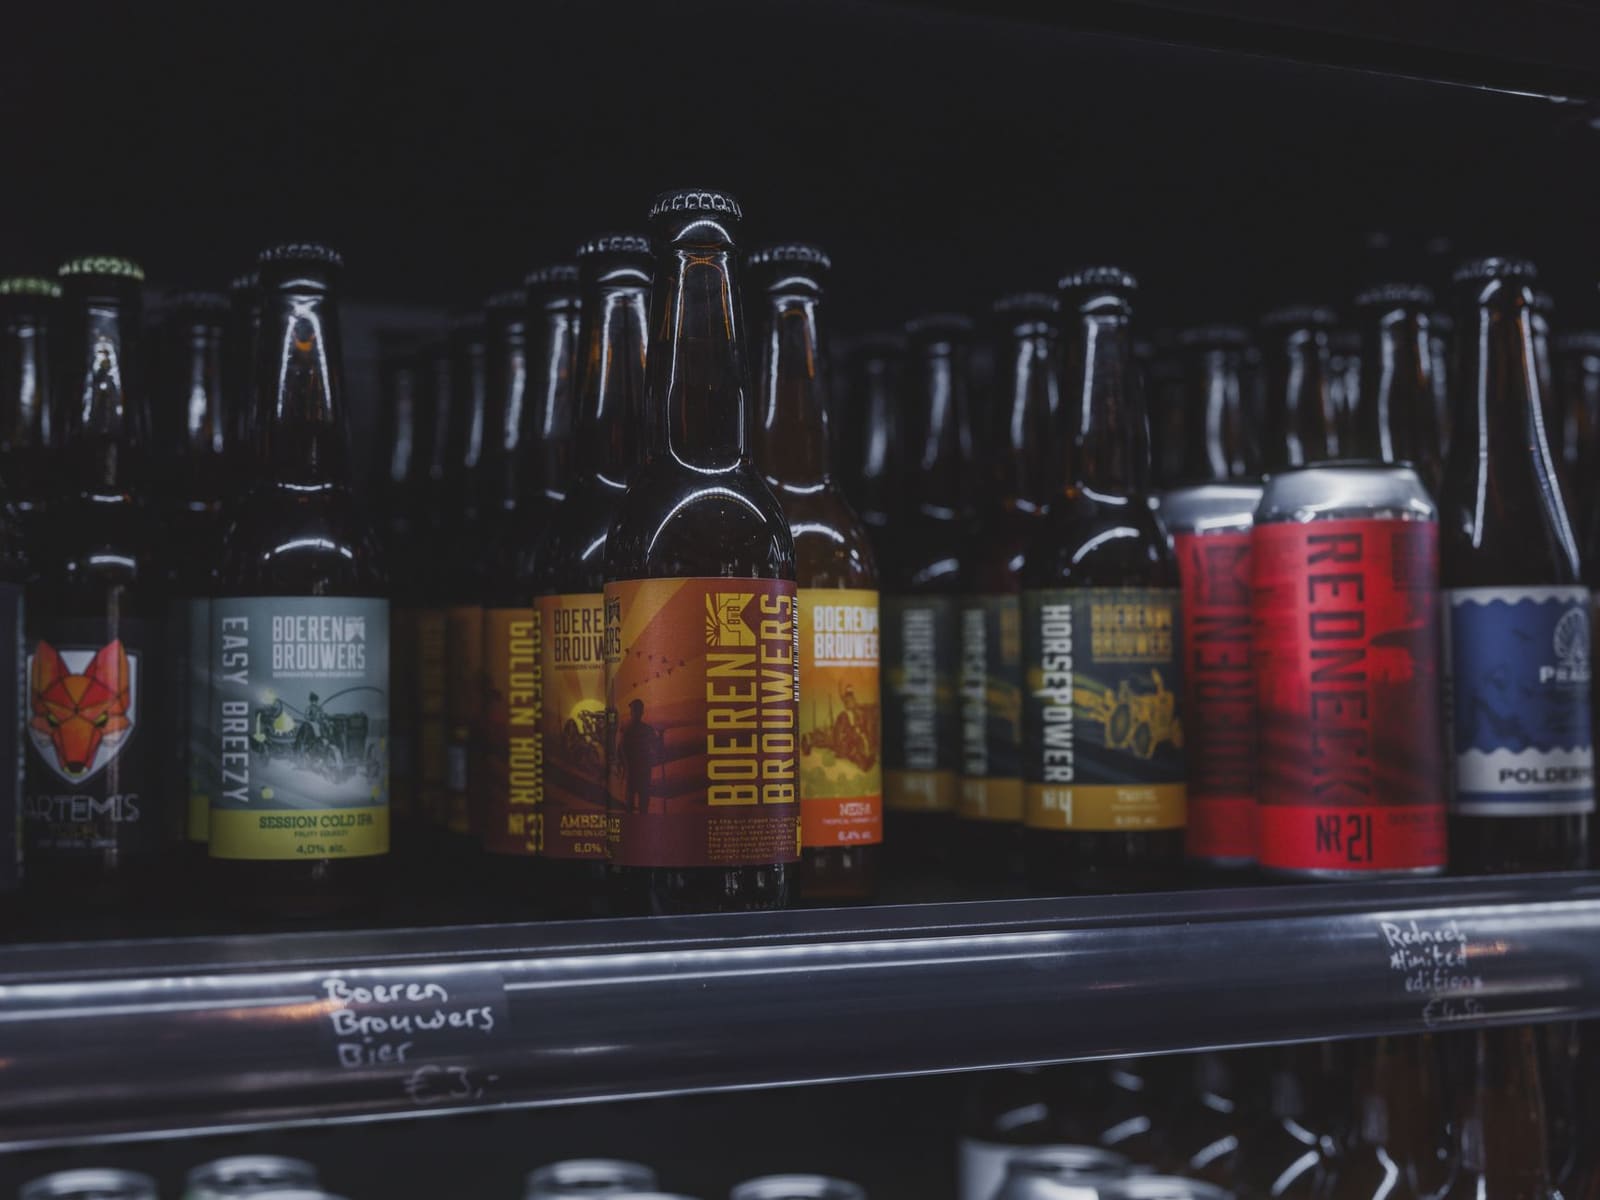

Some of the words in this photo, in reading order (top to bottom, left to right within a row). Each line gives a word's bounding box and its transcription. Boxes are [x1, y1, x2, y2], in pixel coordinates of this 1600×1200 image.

[272, 615, 343, 642] BOEREN
[554, 608, 605, 635] BOERE
[222, 616, 249, 685] EASY
[272, 643, 365, 670] BROUWERS
[1307, 533, 1371, 795] REDNECK
[759, 595, 796, 805] BROUWERS
[1035, 605, 1074, 783] HORSEPOWER
[706, 653, 759, 806] BOEREN
[222, 702, 249, 802] BREEZY
[24, 793, 140, 822] ARTEMIS
[258, 815, 318, 830] SESSION
[320, 814, 356, 828] COLD
[560, 815, 607, 829] AMBER
[1316, 814, 1342, 853] NR
[1346, 813, 1374, 863] 21
[322, 978, 448, 1006] Boeren
[330, 1006, 494, 1036] Brouwers
[338, 1037, 412, 1068] Bier
